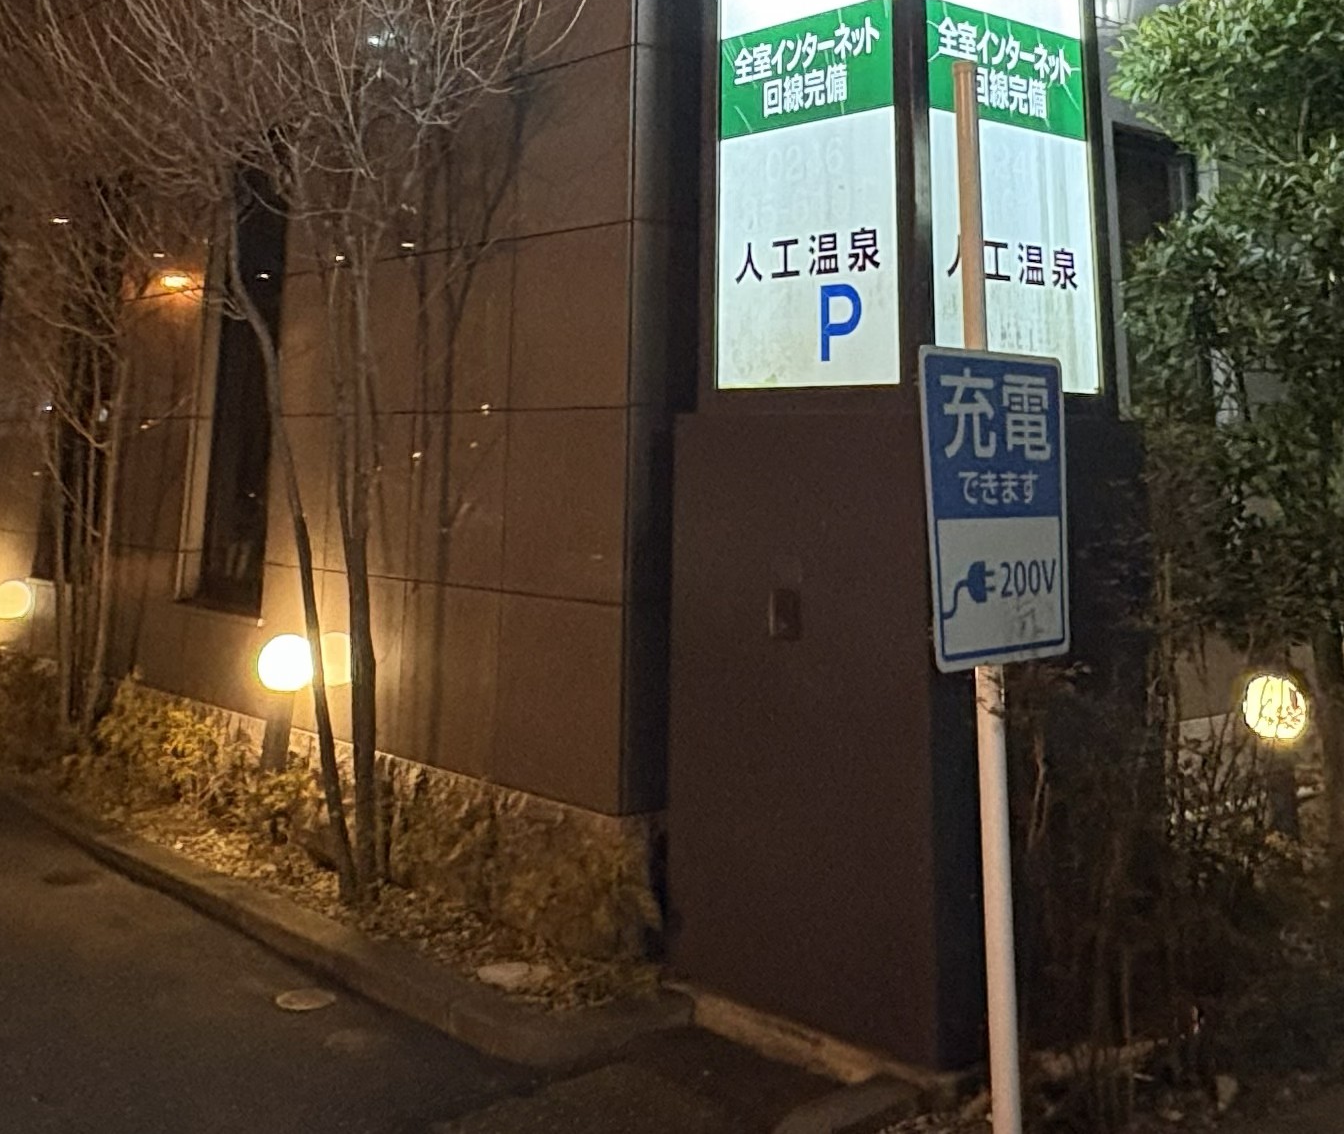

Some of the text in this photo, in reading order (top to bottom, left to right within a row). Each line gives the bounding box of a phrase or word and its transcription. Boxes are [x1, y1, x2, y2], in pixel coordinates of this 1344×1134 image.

[733, 16, 881, 86] 全室インターネット
[937, 16, 1073, 86] 全室インターネット
[762, 62, 848, 119] 回線完備
[735, 227, 881, 285] 人工温泉
[820, 284, 863, 362] P
[939, 367, 1052, 462] 充電
[959, 470, 1039, 505] できます
[1000, 558, 1057, 598] 200V
